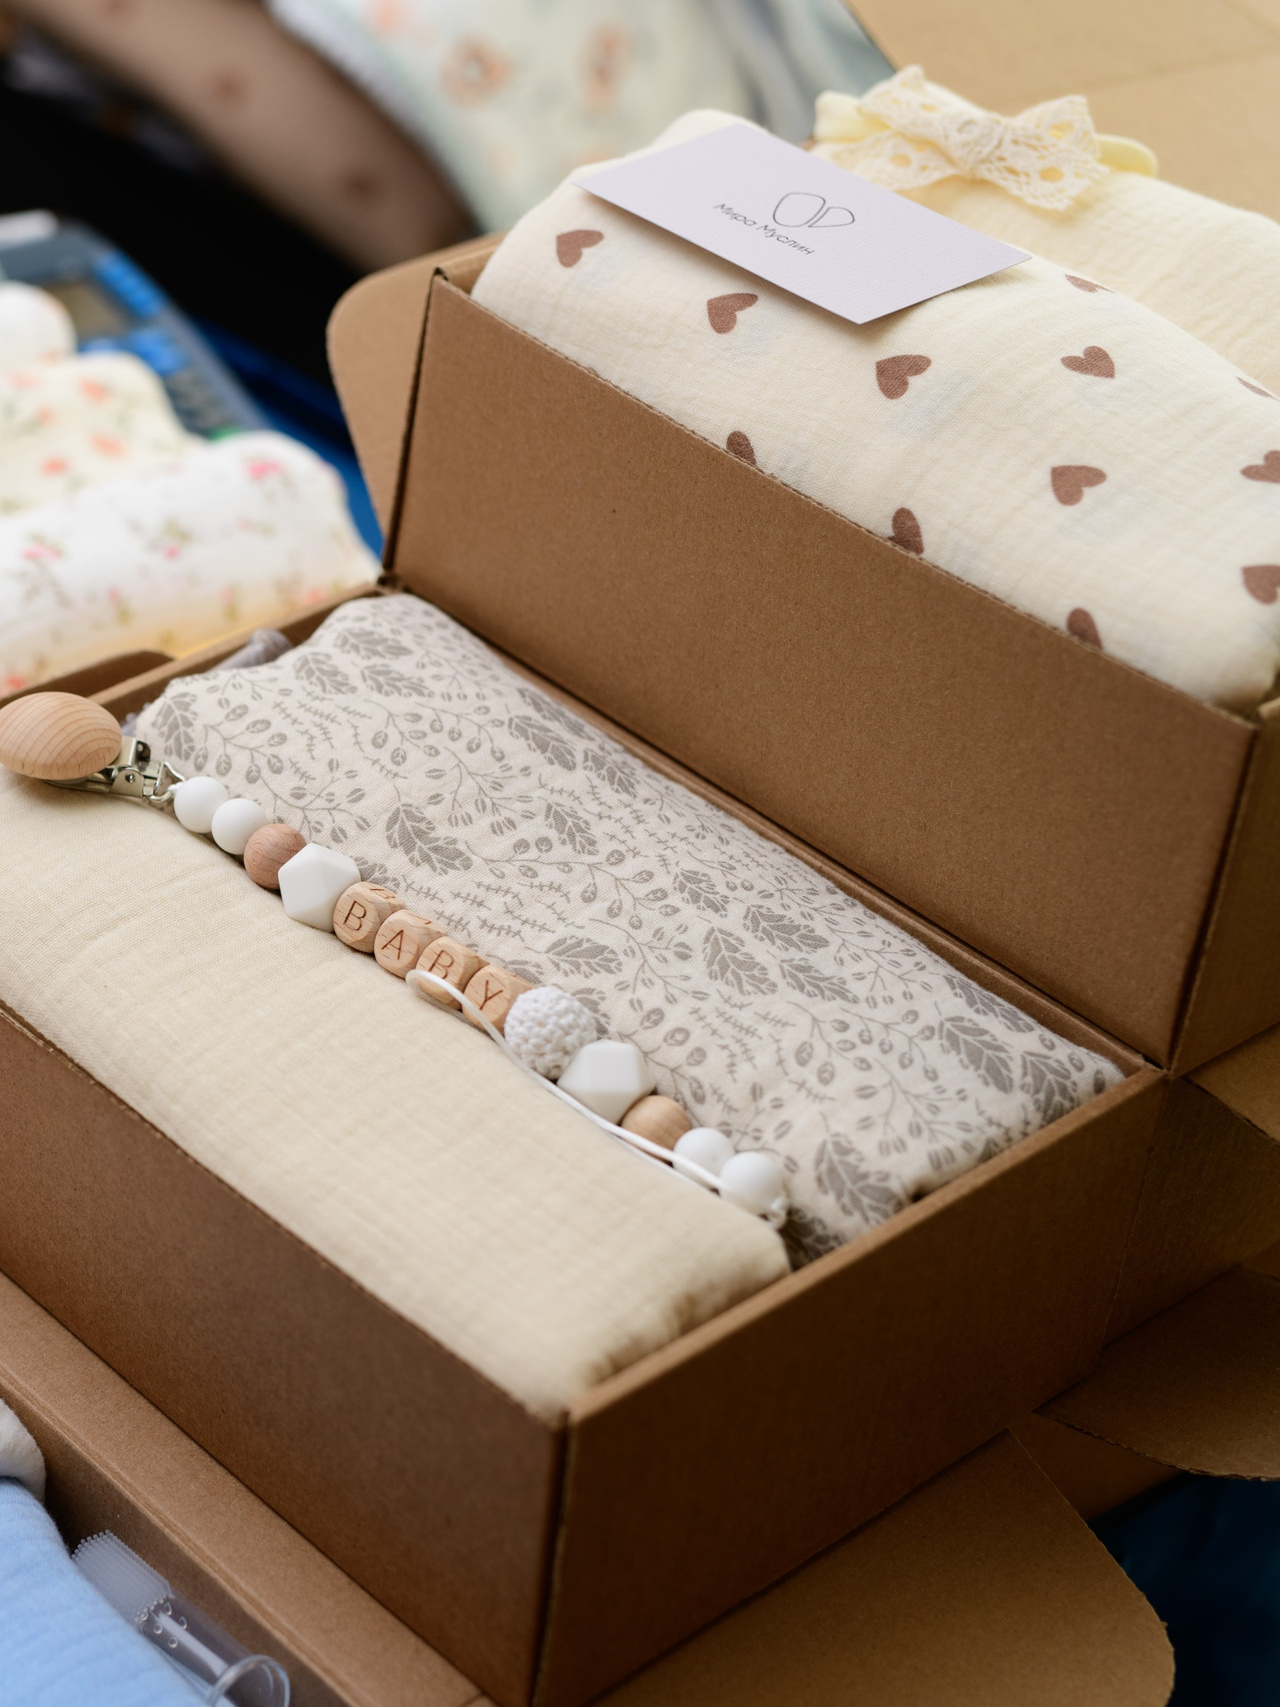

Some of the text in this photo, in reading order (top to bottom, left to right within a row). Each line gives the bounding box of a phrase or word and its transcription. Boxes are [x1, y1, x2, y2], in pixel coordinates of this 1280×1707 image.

[713, 203, 815, 255] Мира Муслин
[343, 899, 504, 1011] BABY
